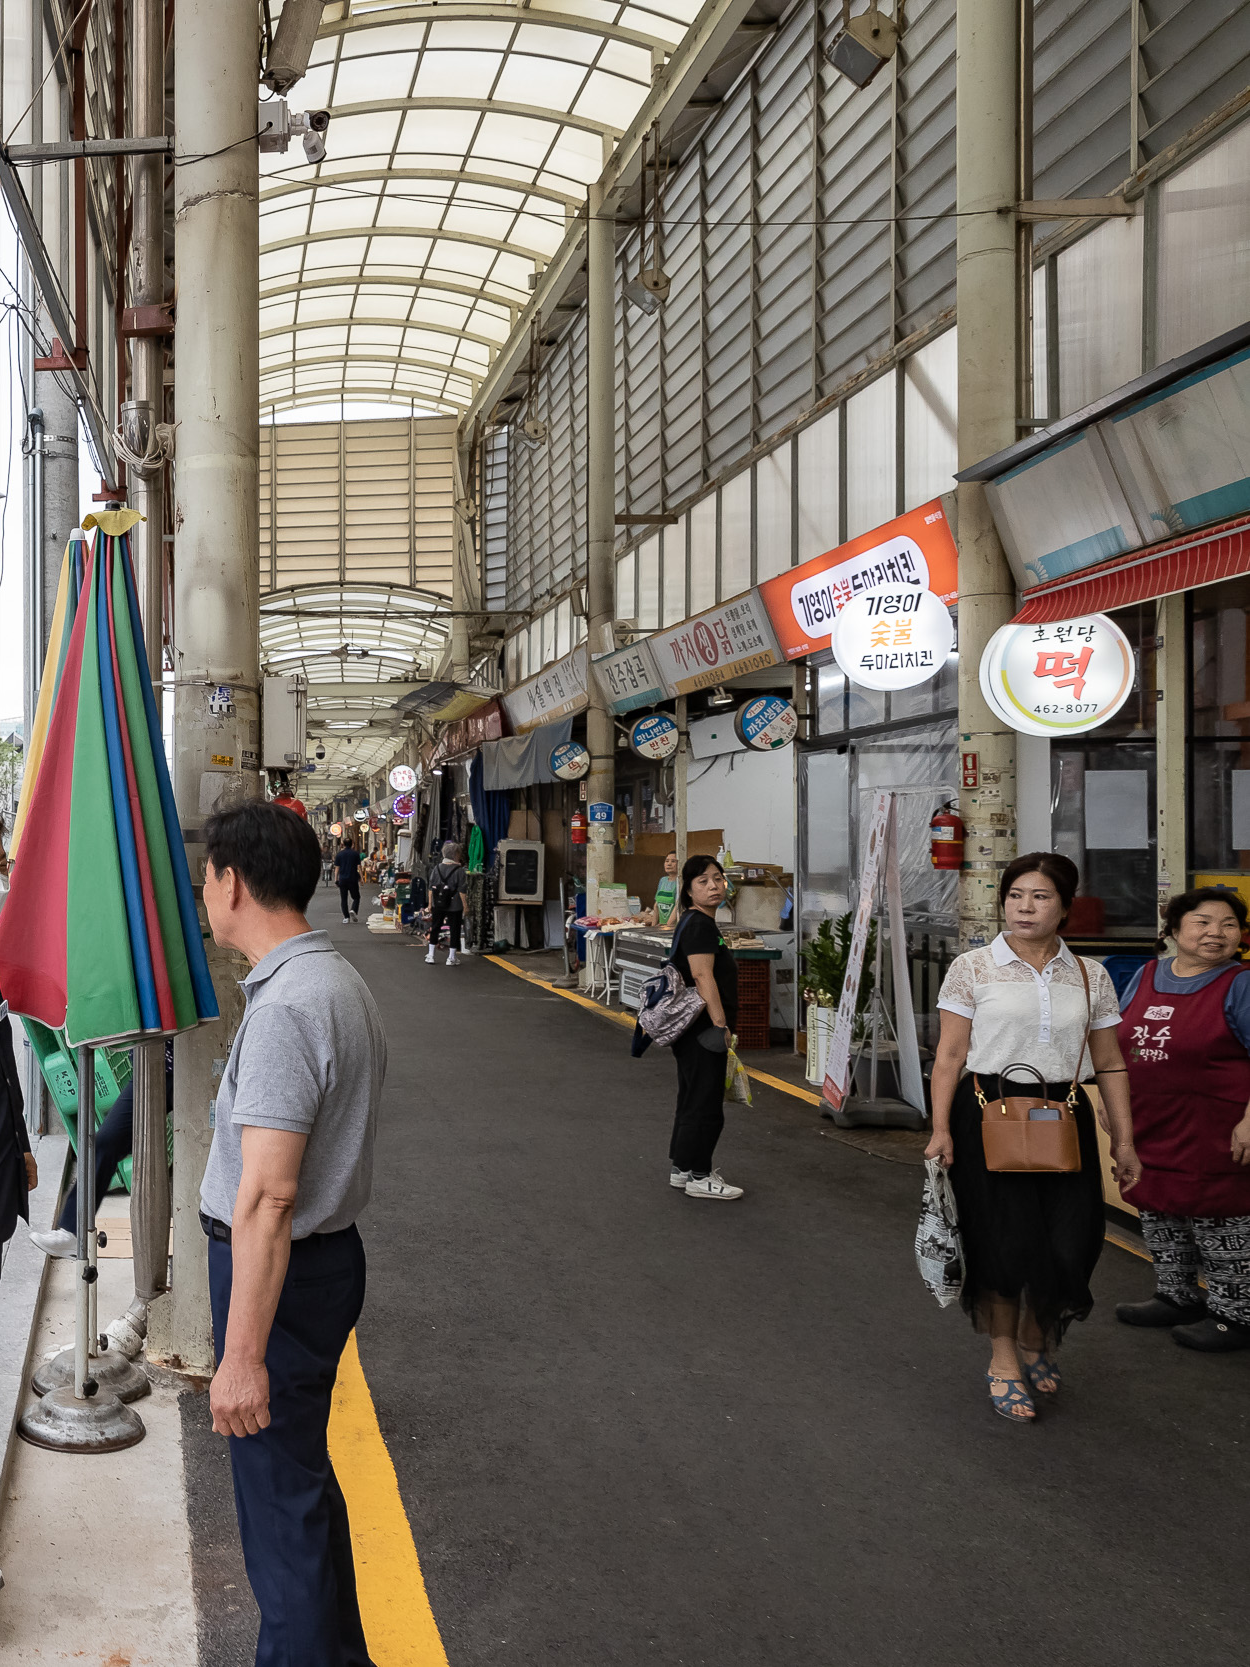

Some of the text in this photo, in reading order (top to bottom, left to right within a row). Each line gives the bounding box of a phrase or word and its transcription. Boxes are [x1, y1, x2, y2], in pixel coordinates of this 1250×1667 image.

[865, 592, 923, 616] 기영이
[870, 618, 912, 648] 숯불
[1032, 625, 1097, 643] 호원당
[669, 617, 735, 672] 까치생닭
[859, 650, 934, 671] 두마리치킨
[605, 655, 649, 695] 전주잡곡
[1032, 646, 1094, 701] 떡
[746, 700, 785, 736] 까치생닭
[1033, 703, 1099, 714] 462-8077
[636, 721, 672, 744] 맛나반찬
[649, 735, 670, 751] 반찬
[759, 731, 773, 745] 생
[595, 812, 607, 820] 49
[1130, 1025, 1172, 1047] 장수
[1129, 1047, 1169, 1063] 생막걸리
